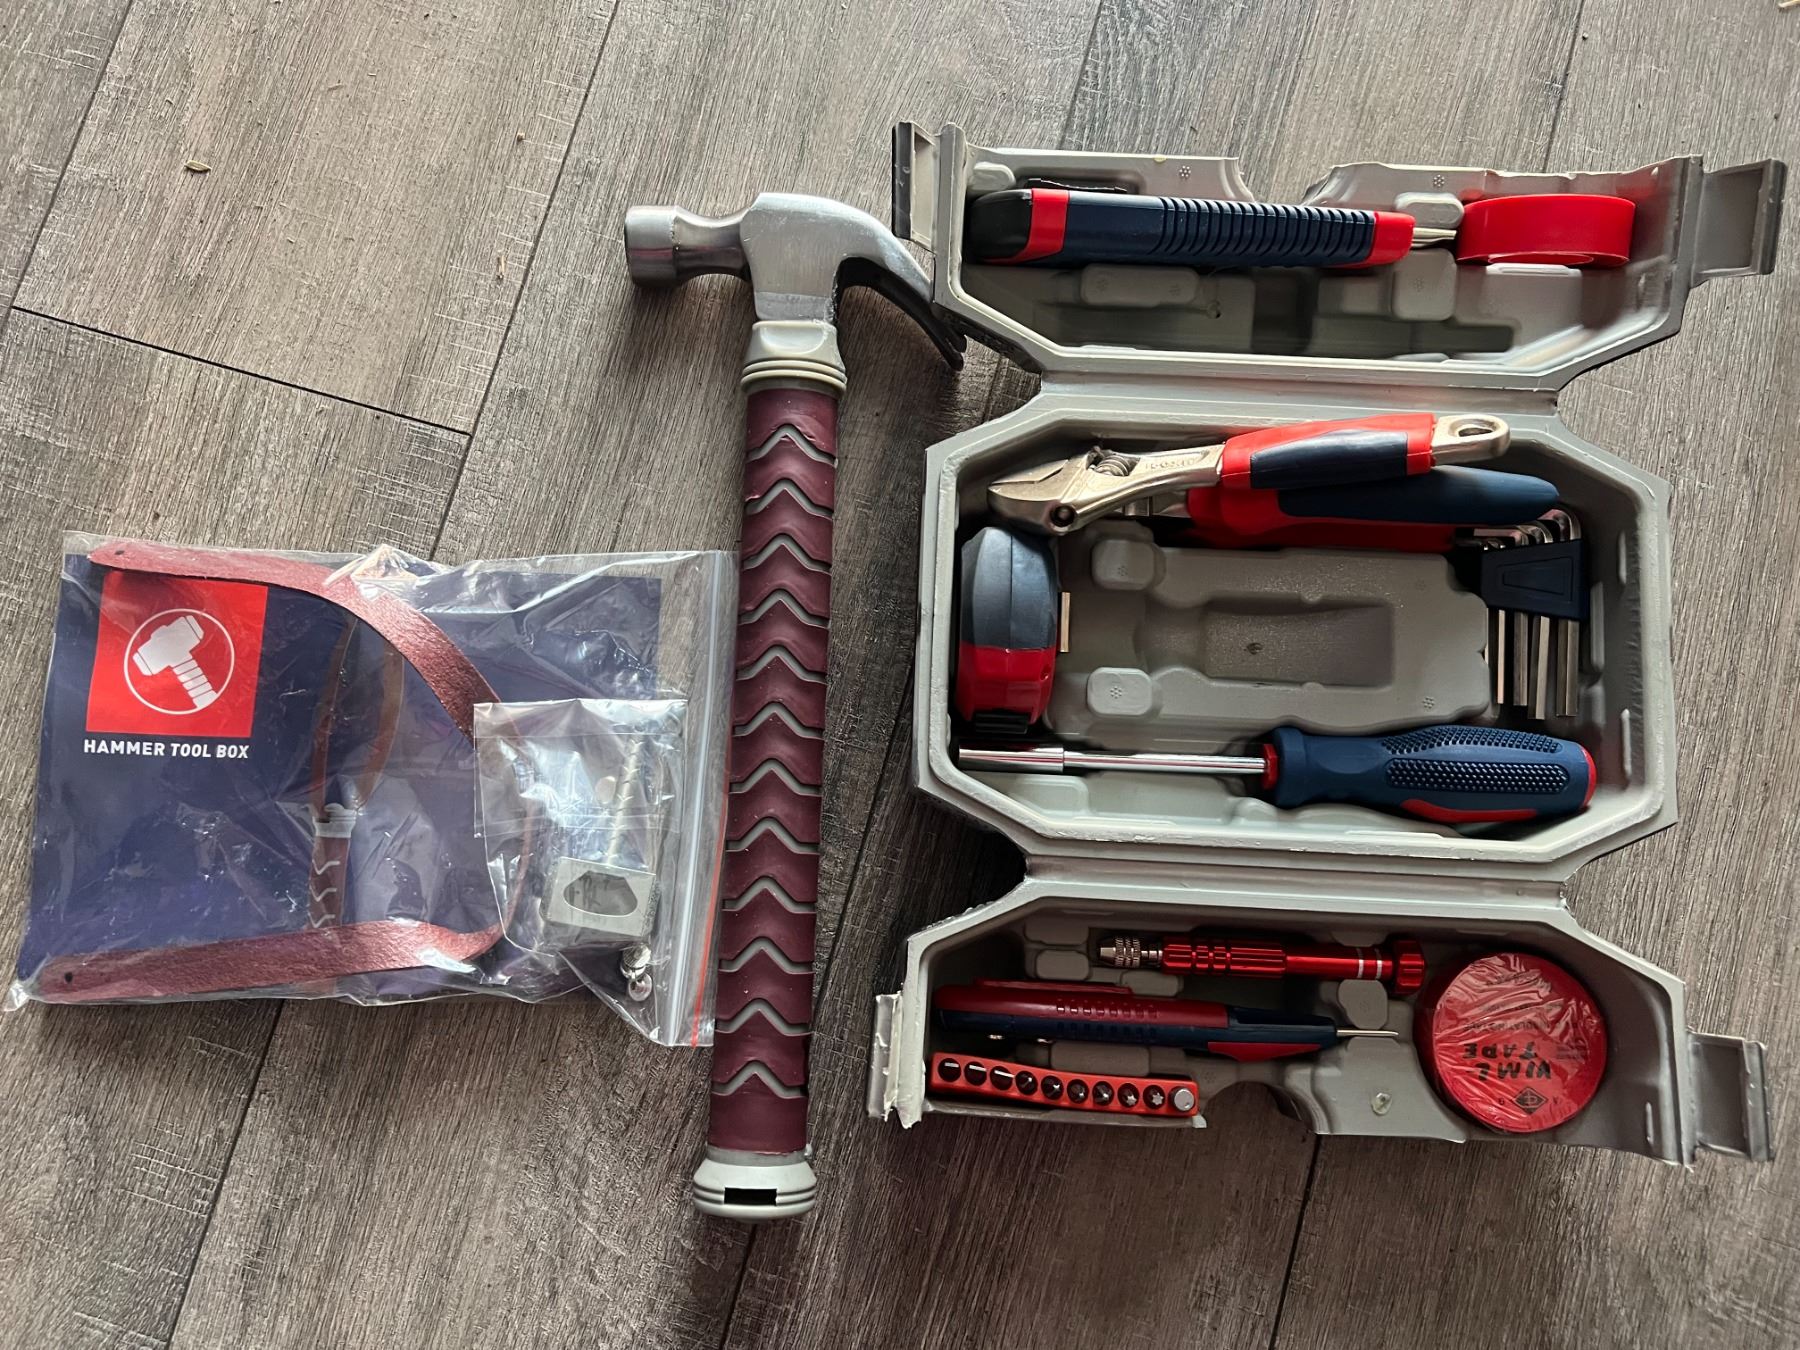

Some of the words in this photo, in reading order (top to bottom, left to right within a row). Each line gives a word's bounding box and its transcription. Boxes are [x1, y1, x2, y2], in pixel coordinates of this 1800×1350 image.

[83, 739, 166, 756] HAMMER
[170, 742, 212, 758] TOOL
[216, 744, 250, 759] BOX
[1462, 1041, 1538, 1060] TAPE
